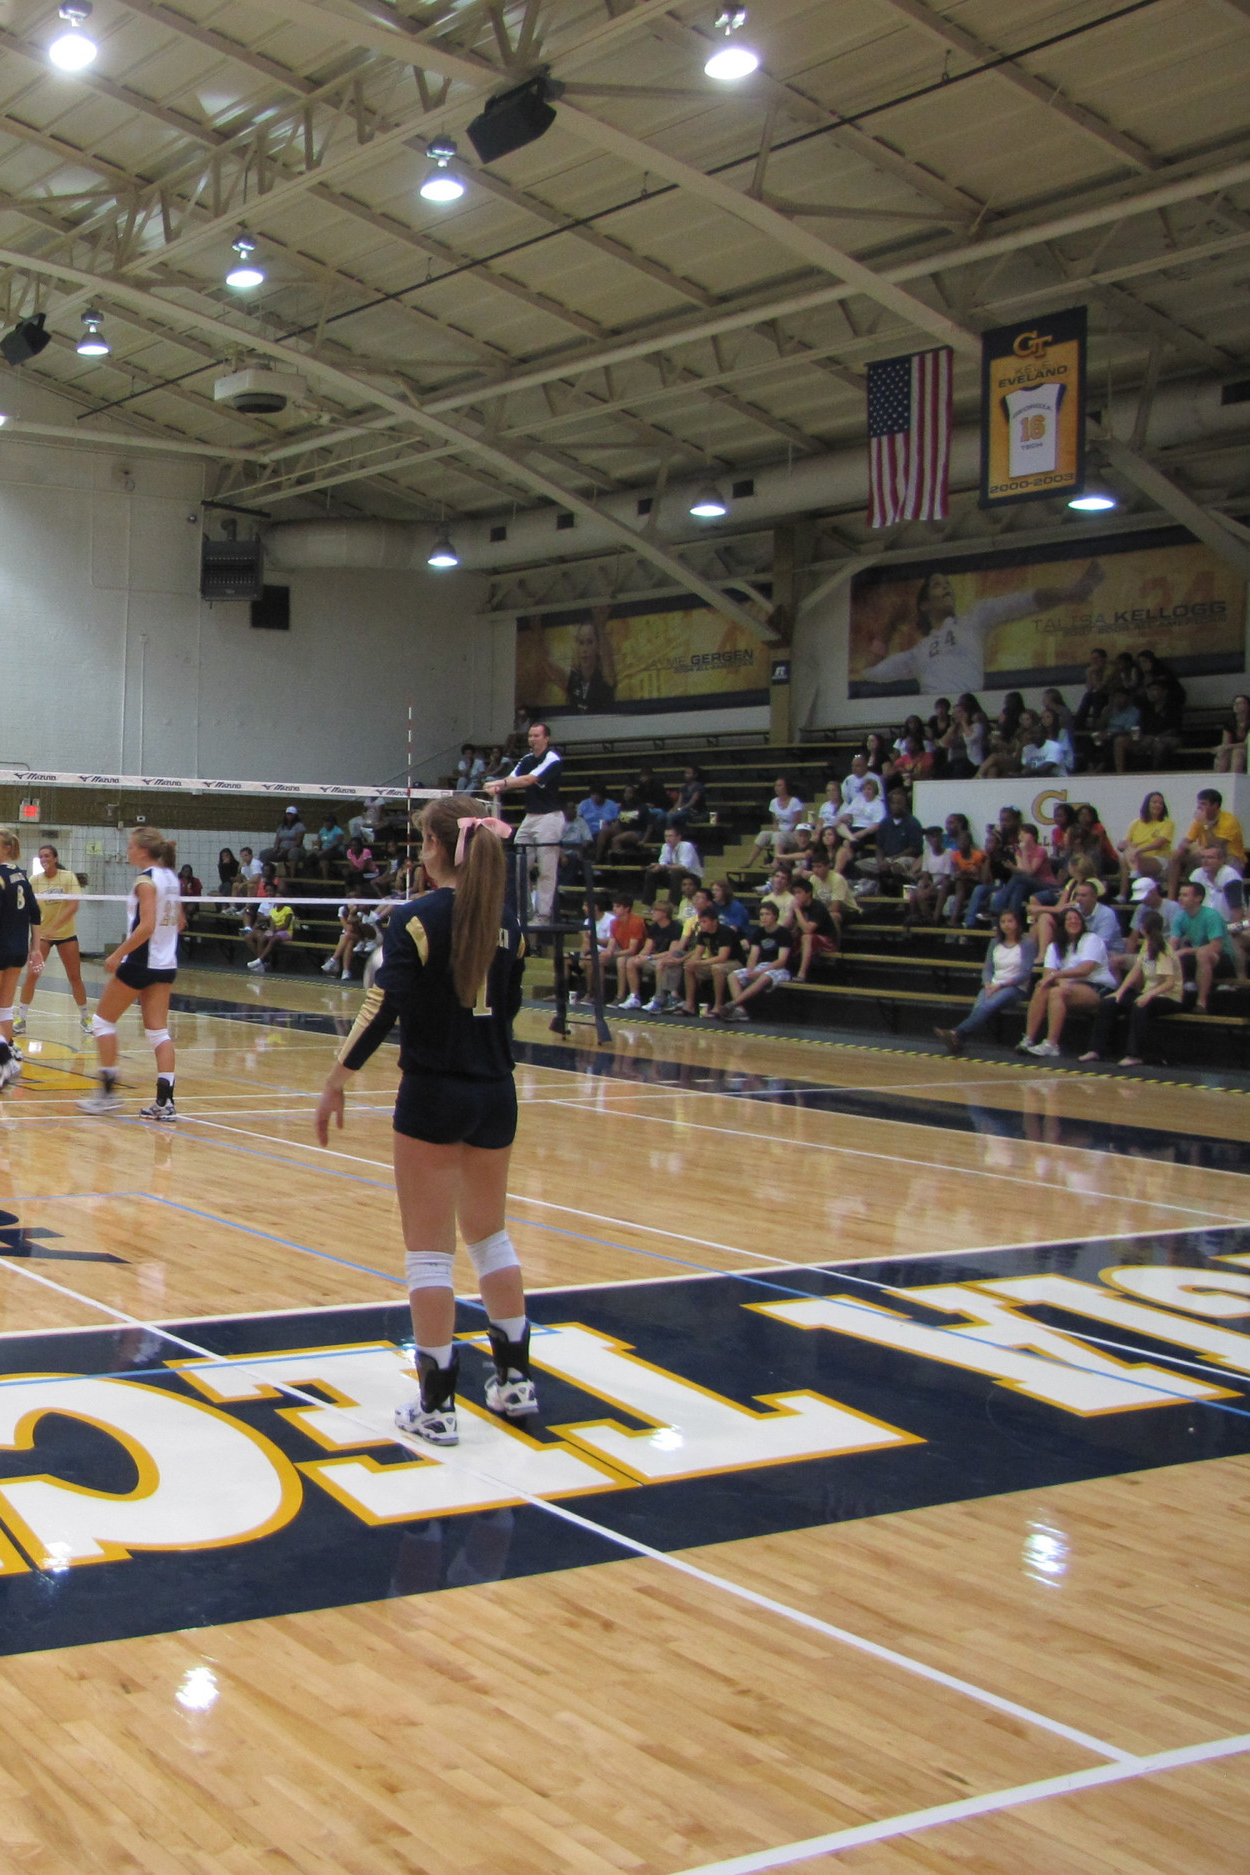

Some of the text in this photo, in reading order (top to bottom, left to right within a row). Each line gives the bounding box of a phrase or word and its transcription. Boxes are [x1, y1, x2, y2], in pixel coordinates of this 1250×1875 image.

[1013, 330, 1053, 359] GT
[998, 365, 1068, 388] EVELAND
[989, 473, 1075, 494] 2000-2003
[1114, 600, 1227, 625] KELLOGG
[691, 649, 754, 665] GERGEN
